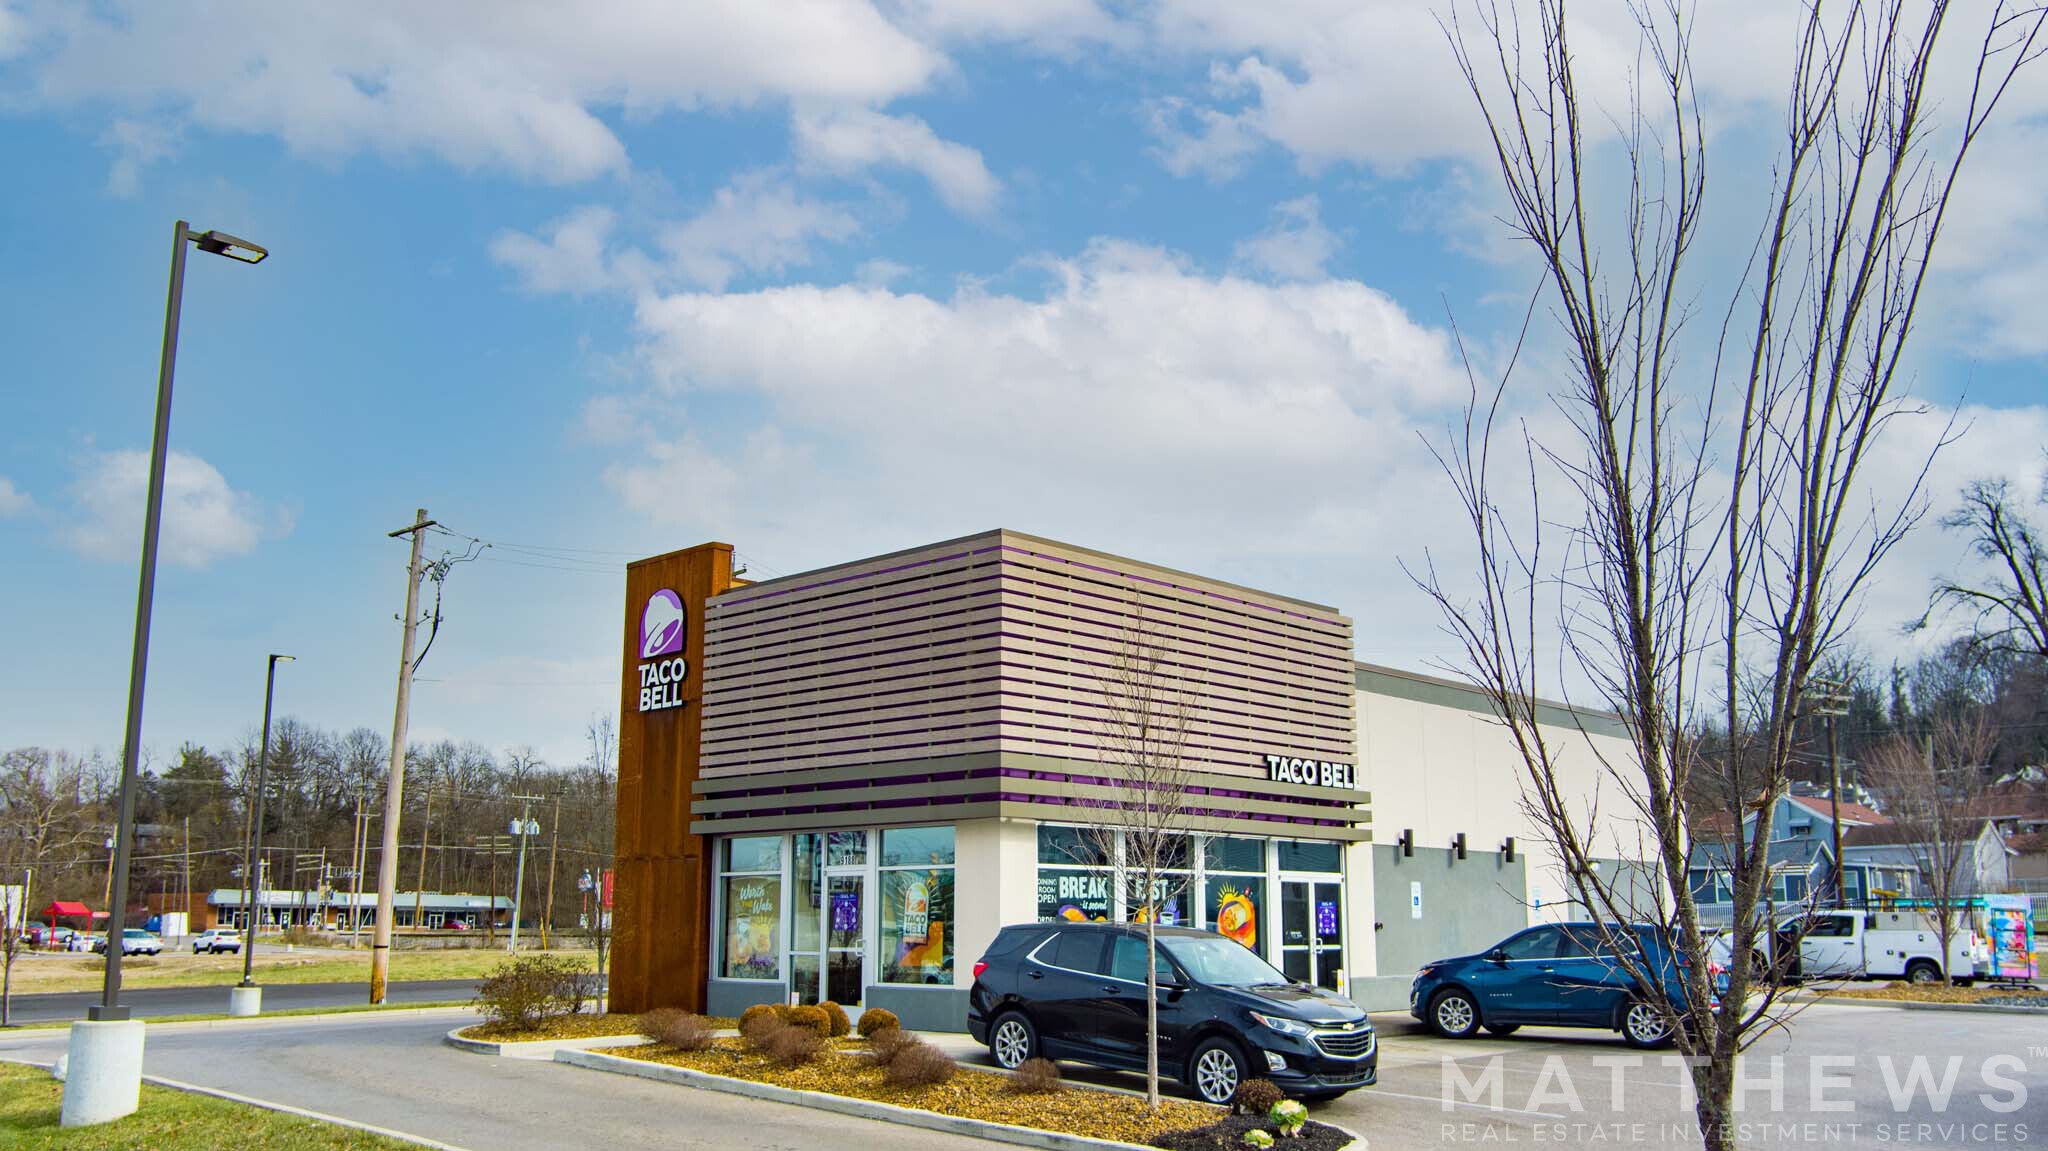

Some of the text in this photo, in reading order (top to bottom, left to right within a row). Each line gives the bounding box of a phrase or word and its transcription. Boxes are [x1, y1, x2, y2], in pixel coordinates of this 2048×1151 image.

[638, 658, 685, 688] TACO
[640, 683, 682, 711] BELL
[1267, 755, 1317, 784] TACO
[1038, 886, 1056, 894] ROOM
[1059, 876, 1107, 898] BREAK
[1038, 894, 1057, 903] OPEN
[905, 914, 927, 925] TACO
[905, 925, 926, 935] BELL
